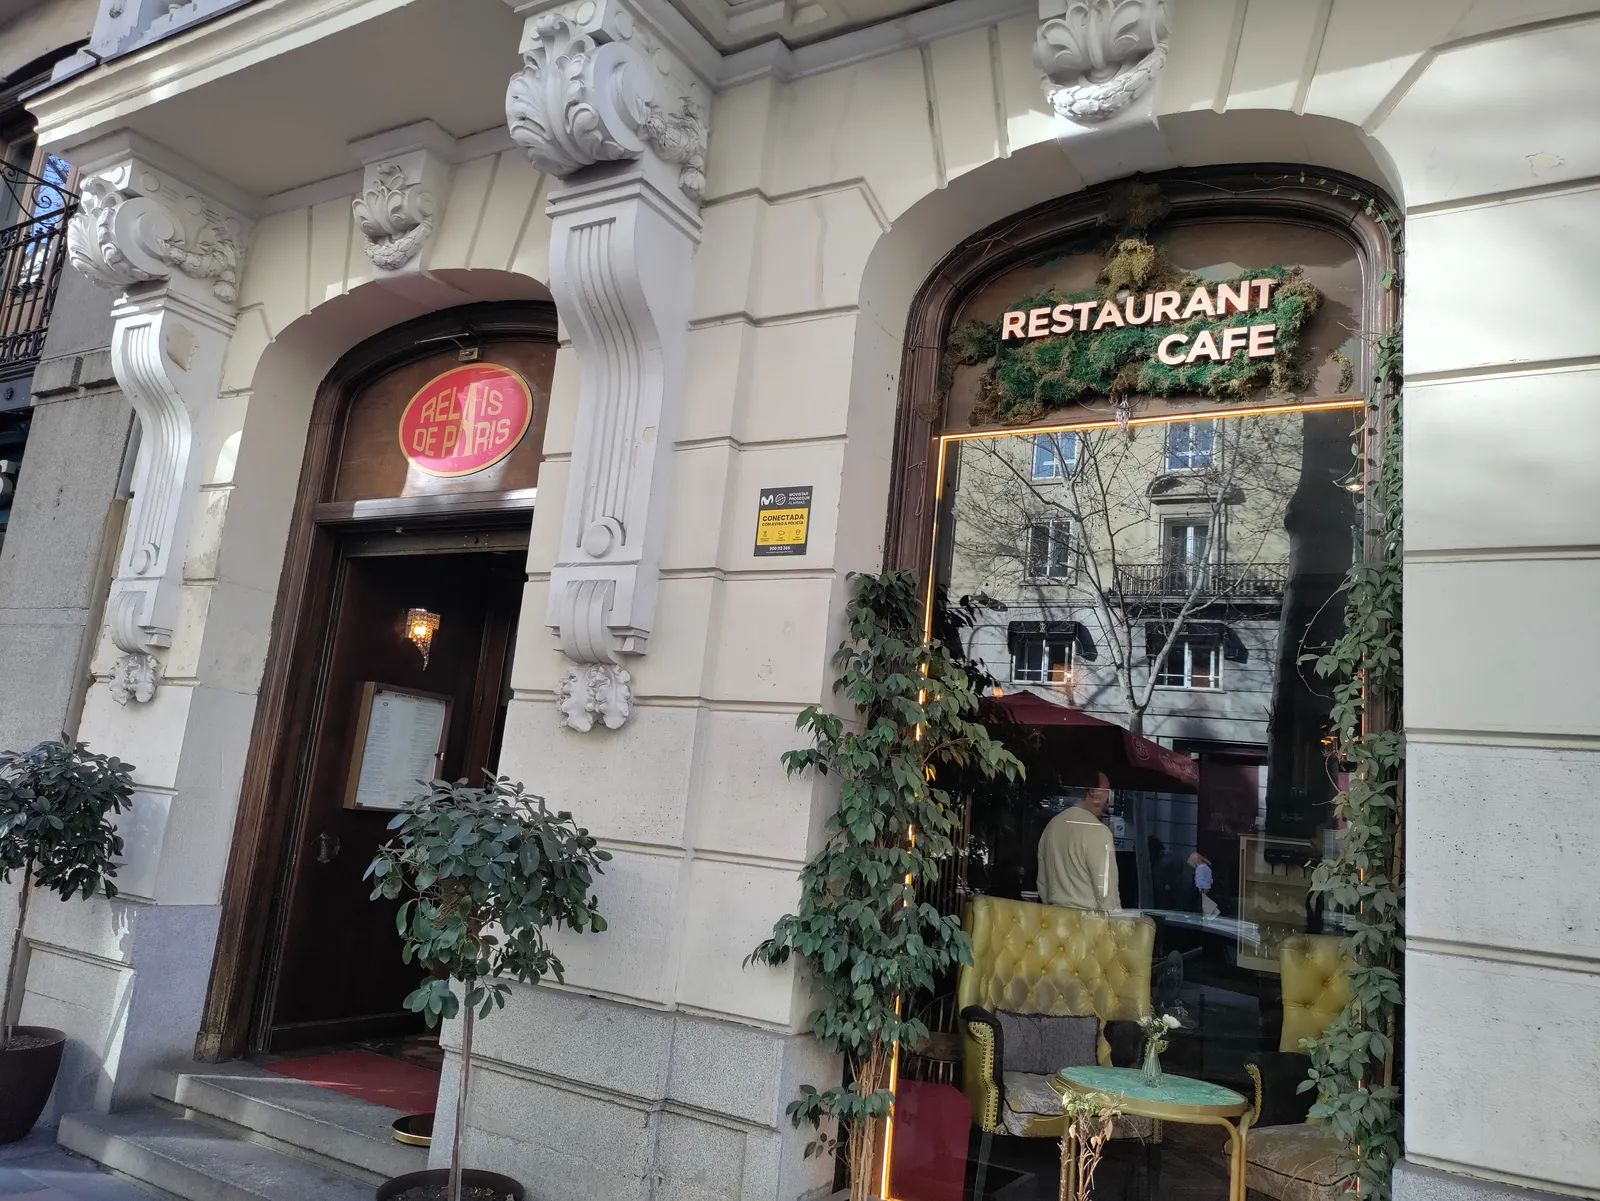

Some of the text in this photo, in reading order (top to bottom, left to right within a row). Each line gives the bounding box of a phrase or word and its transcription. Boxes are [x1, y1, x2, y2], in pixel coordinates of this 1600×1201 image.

[1001, 278, 1278, 341] RESTAURANT
[1157, 324, 1276, 367] CAFE
[420, 382, 504, 424] RELAIS
[413, 418, 511, 458] DE PARIS
[762, 514, 804, 522] CONECTADA
